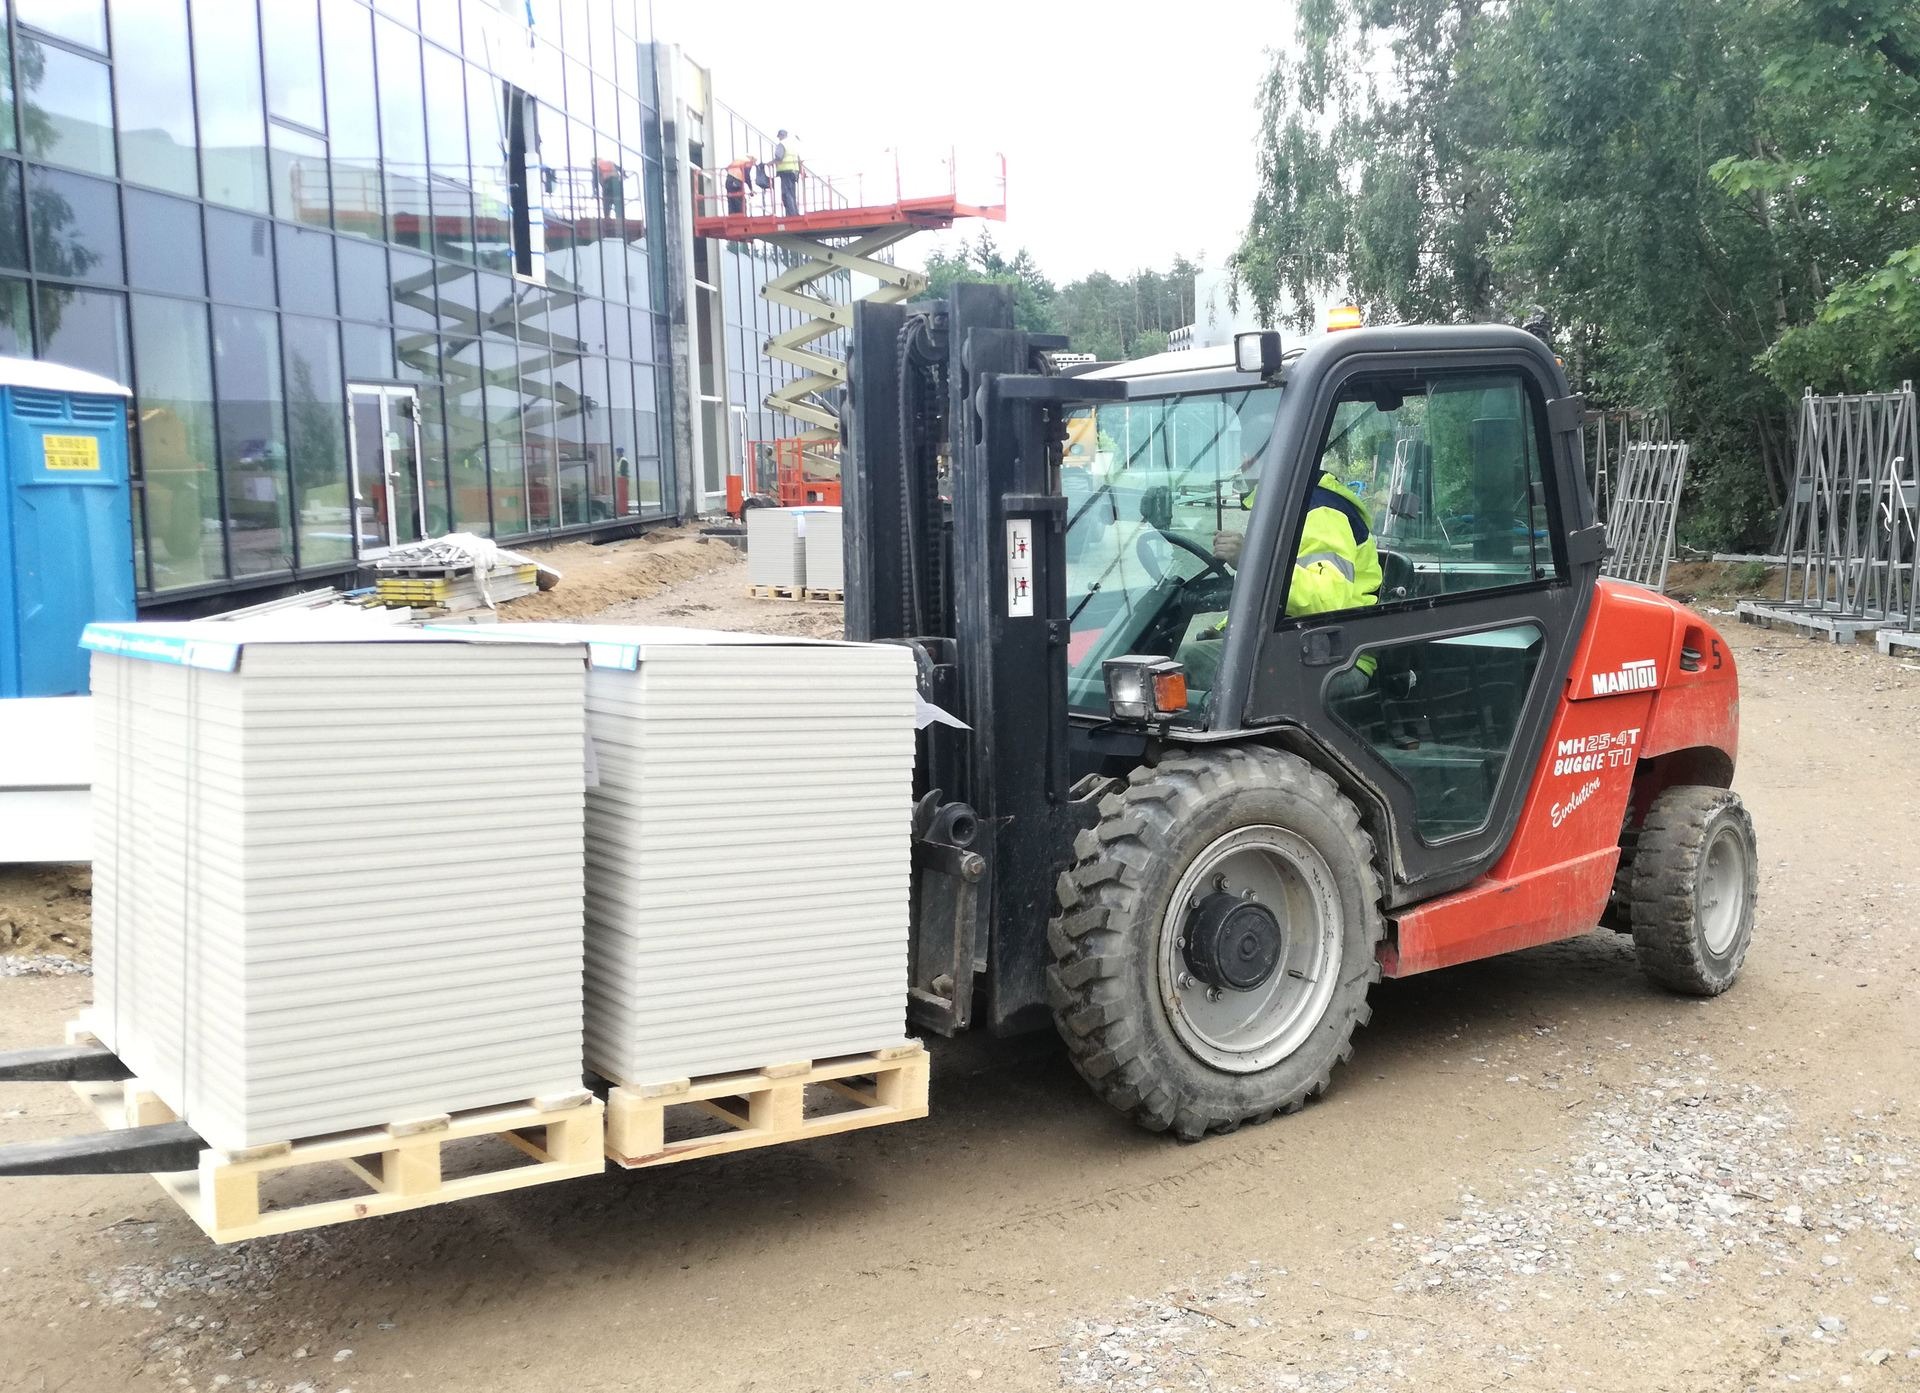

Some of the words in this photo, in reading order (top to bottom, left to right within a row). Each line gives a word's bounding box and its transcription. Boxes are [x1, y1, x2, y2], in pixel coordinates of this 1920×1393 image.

[1712, 640, 1721, 669] 5
[1592, 659, 1657, 694] MANITOU
[1554, 753, 1603, 776] BUGGIE
[1608, 748, 1632, 767] TI
[1551, 777, 1600, 828] Evolution
